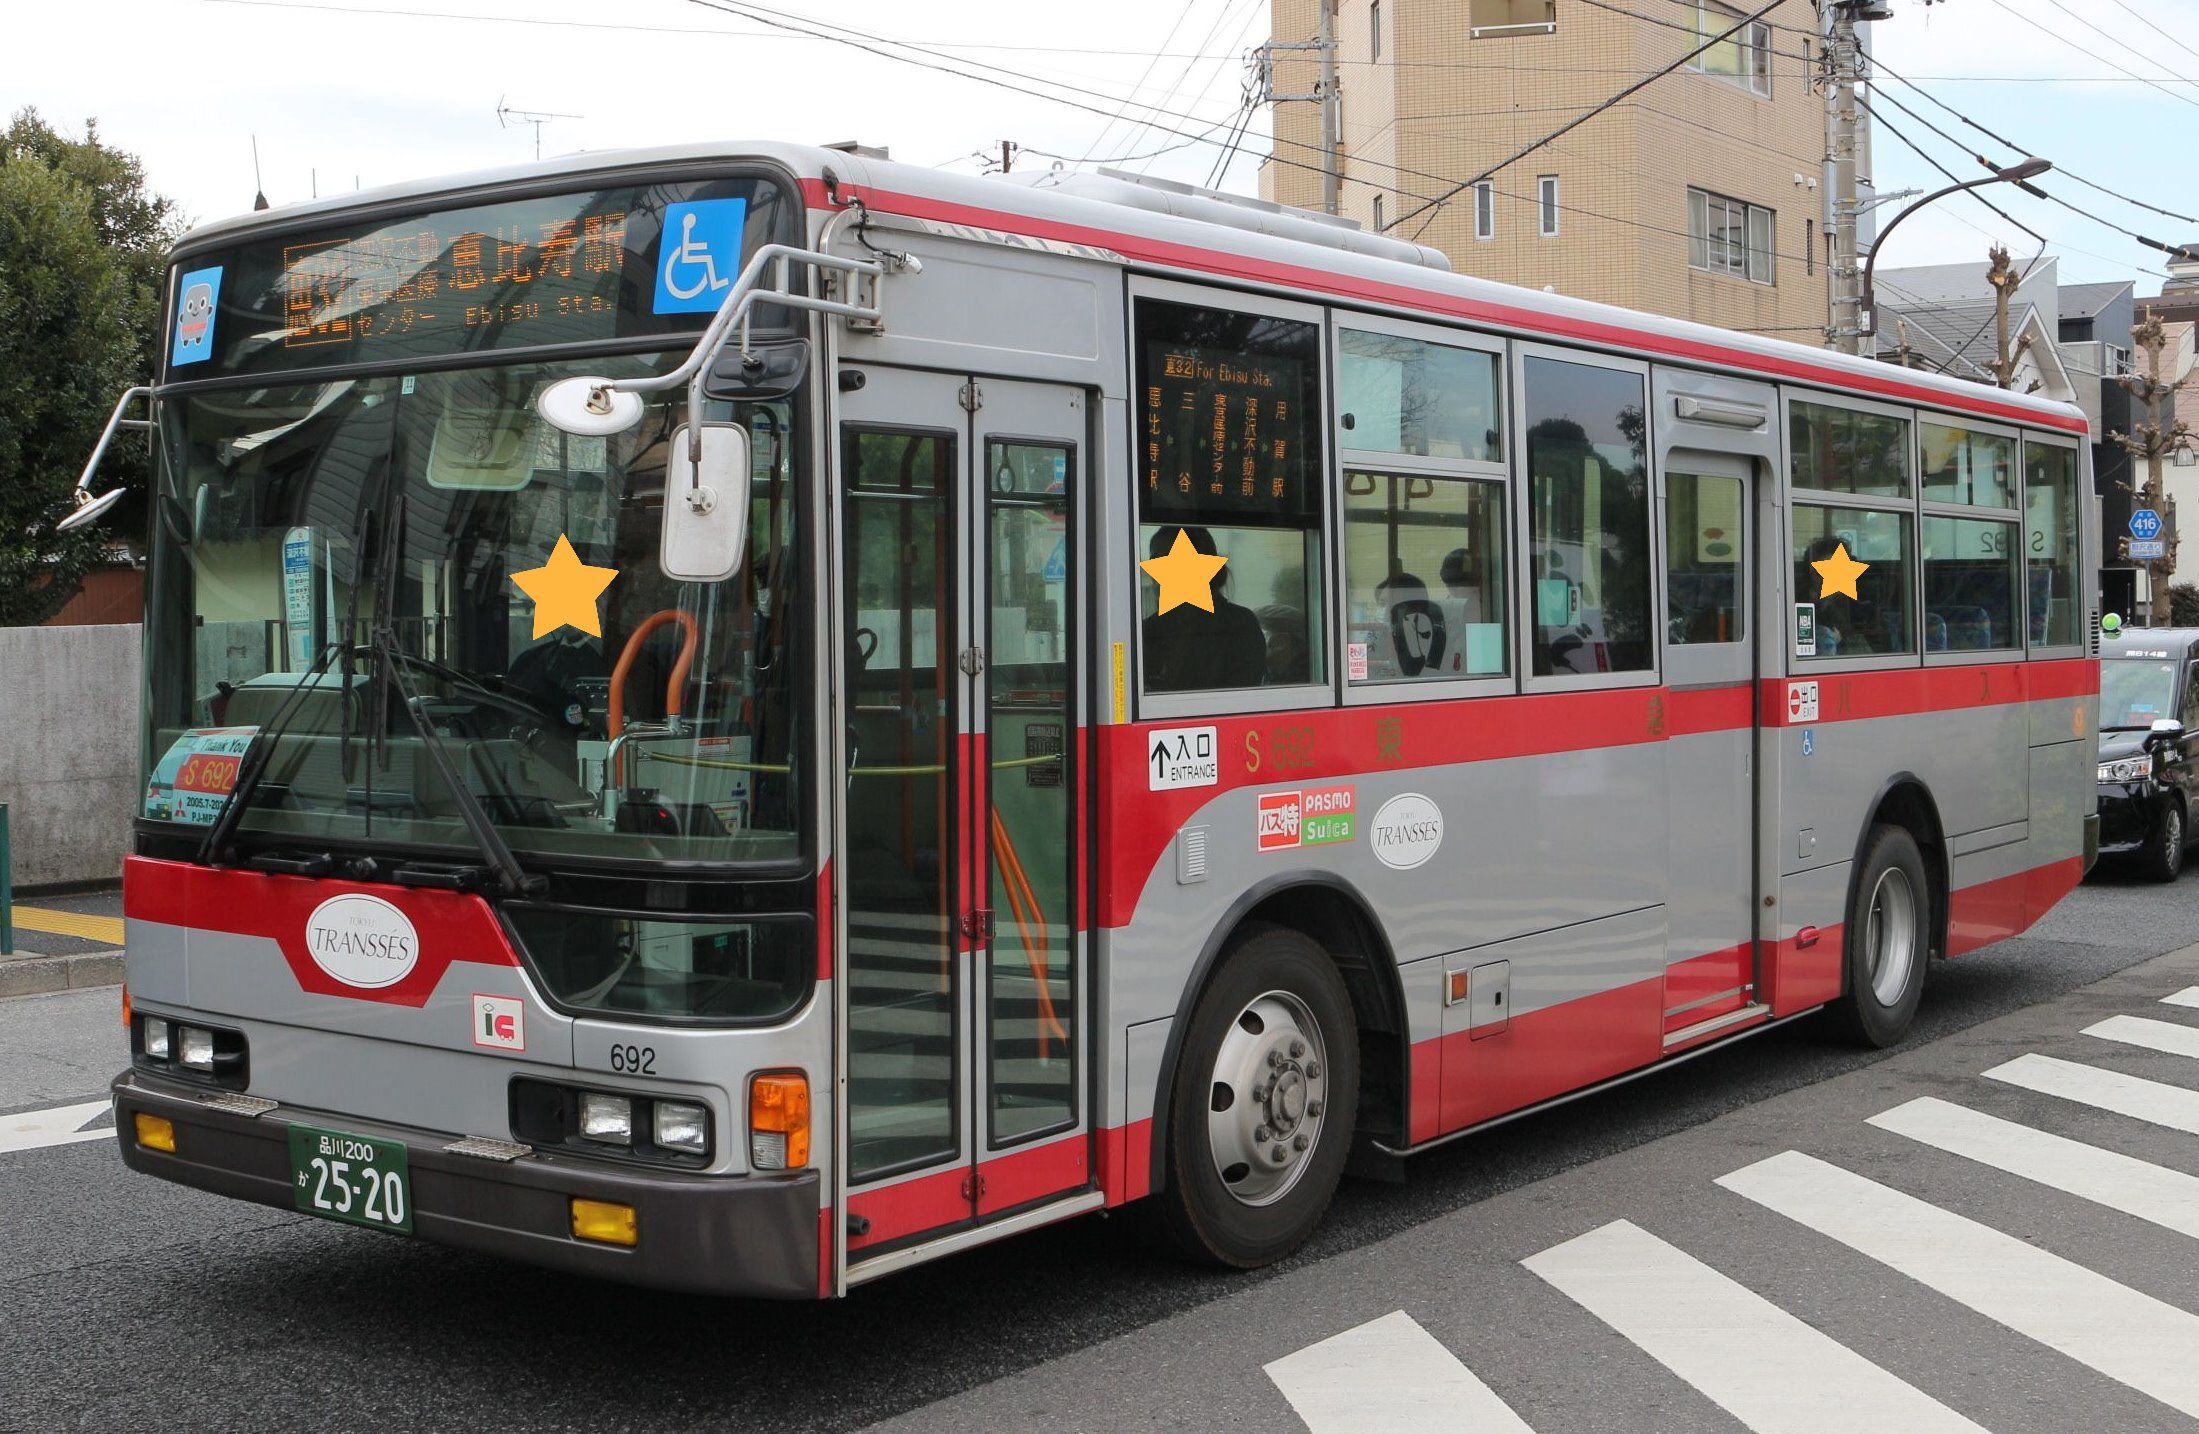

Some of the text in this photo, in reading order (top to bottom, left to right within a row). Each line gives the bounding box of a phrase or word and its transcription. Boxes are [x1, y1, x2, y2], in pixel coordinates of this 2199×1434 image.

[448, 213, 625, 290] 恵比寿駅
[465, 295, 612, 327] Ebisu Sta.
[1197, 361, 1214, 380] For
[1219, 363, 1248, 384] Ebisu
[1252, 368, 1273, 386] Sta.
[2134, 517, 2157, 530] 416
[1802, 686, 1817, 704] 出口
[1176, 733, 1211, 761] 入口
[1245, 727, 1316, 773] S 692
[185, 759, 234, 790] S 692
[1171, 763, 1217, 781] ENTRANCE
[1305, 791, 1351, 813] PASMO
[1260, 802, 1300, 838] バス特
[1307, 817, 1350, 840] Suica
[1376, 816, 1439, 847] TRANSSÉS
[314, 927, 410, 961] TRANSSÉS
[610, 1044, 657, 1075] 692
[298, 1157, 405, 1224] か 25-20
